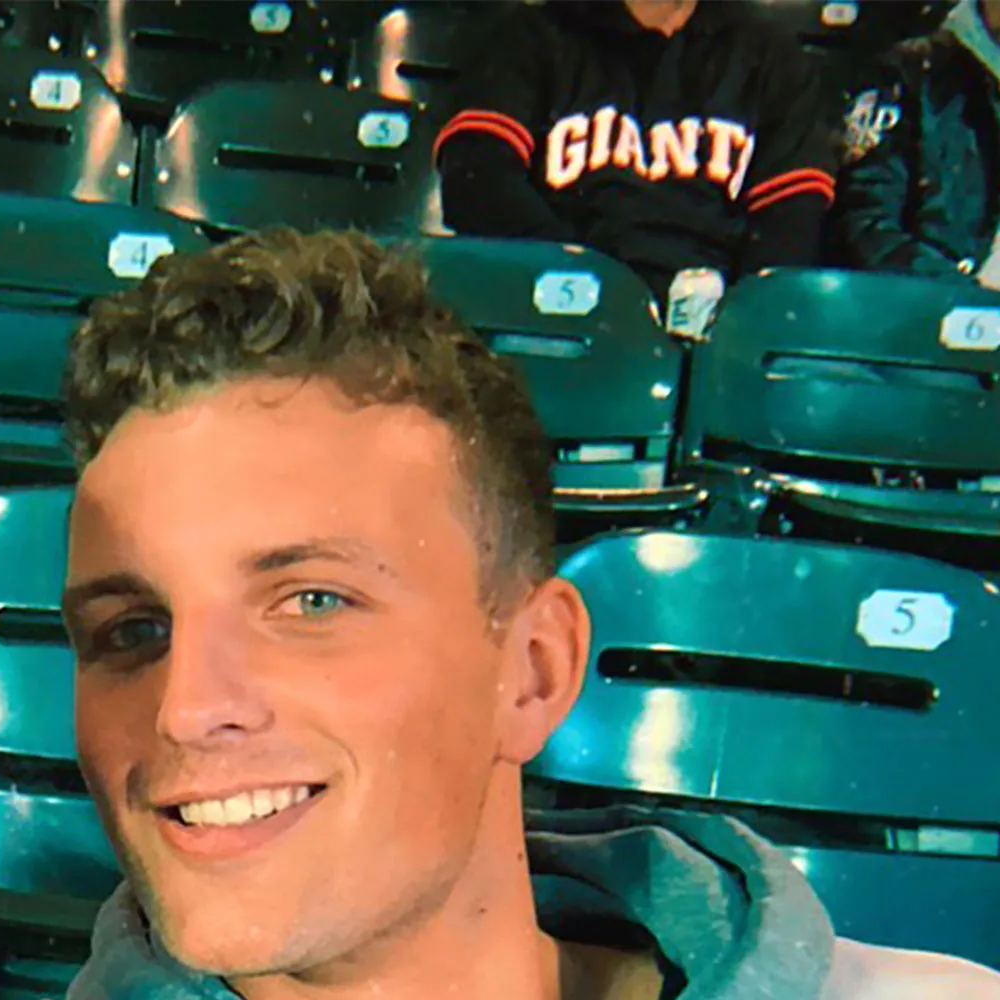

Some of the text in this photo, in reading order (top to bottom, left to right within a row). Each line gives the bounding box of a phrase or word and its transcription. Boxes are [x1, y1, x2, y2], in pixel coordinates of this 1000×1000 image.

[130, 240, 148, 272] 4
[556, 277, 576, 310] 5
[964, 313, 986, 342] 6
[890, 597, 920, 636] 5
